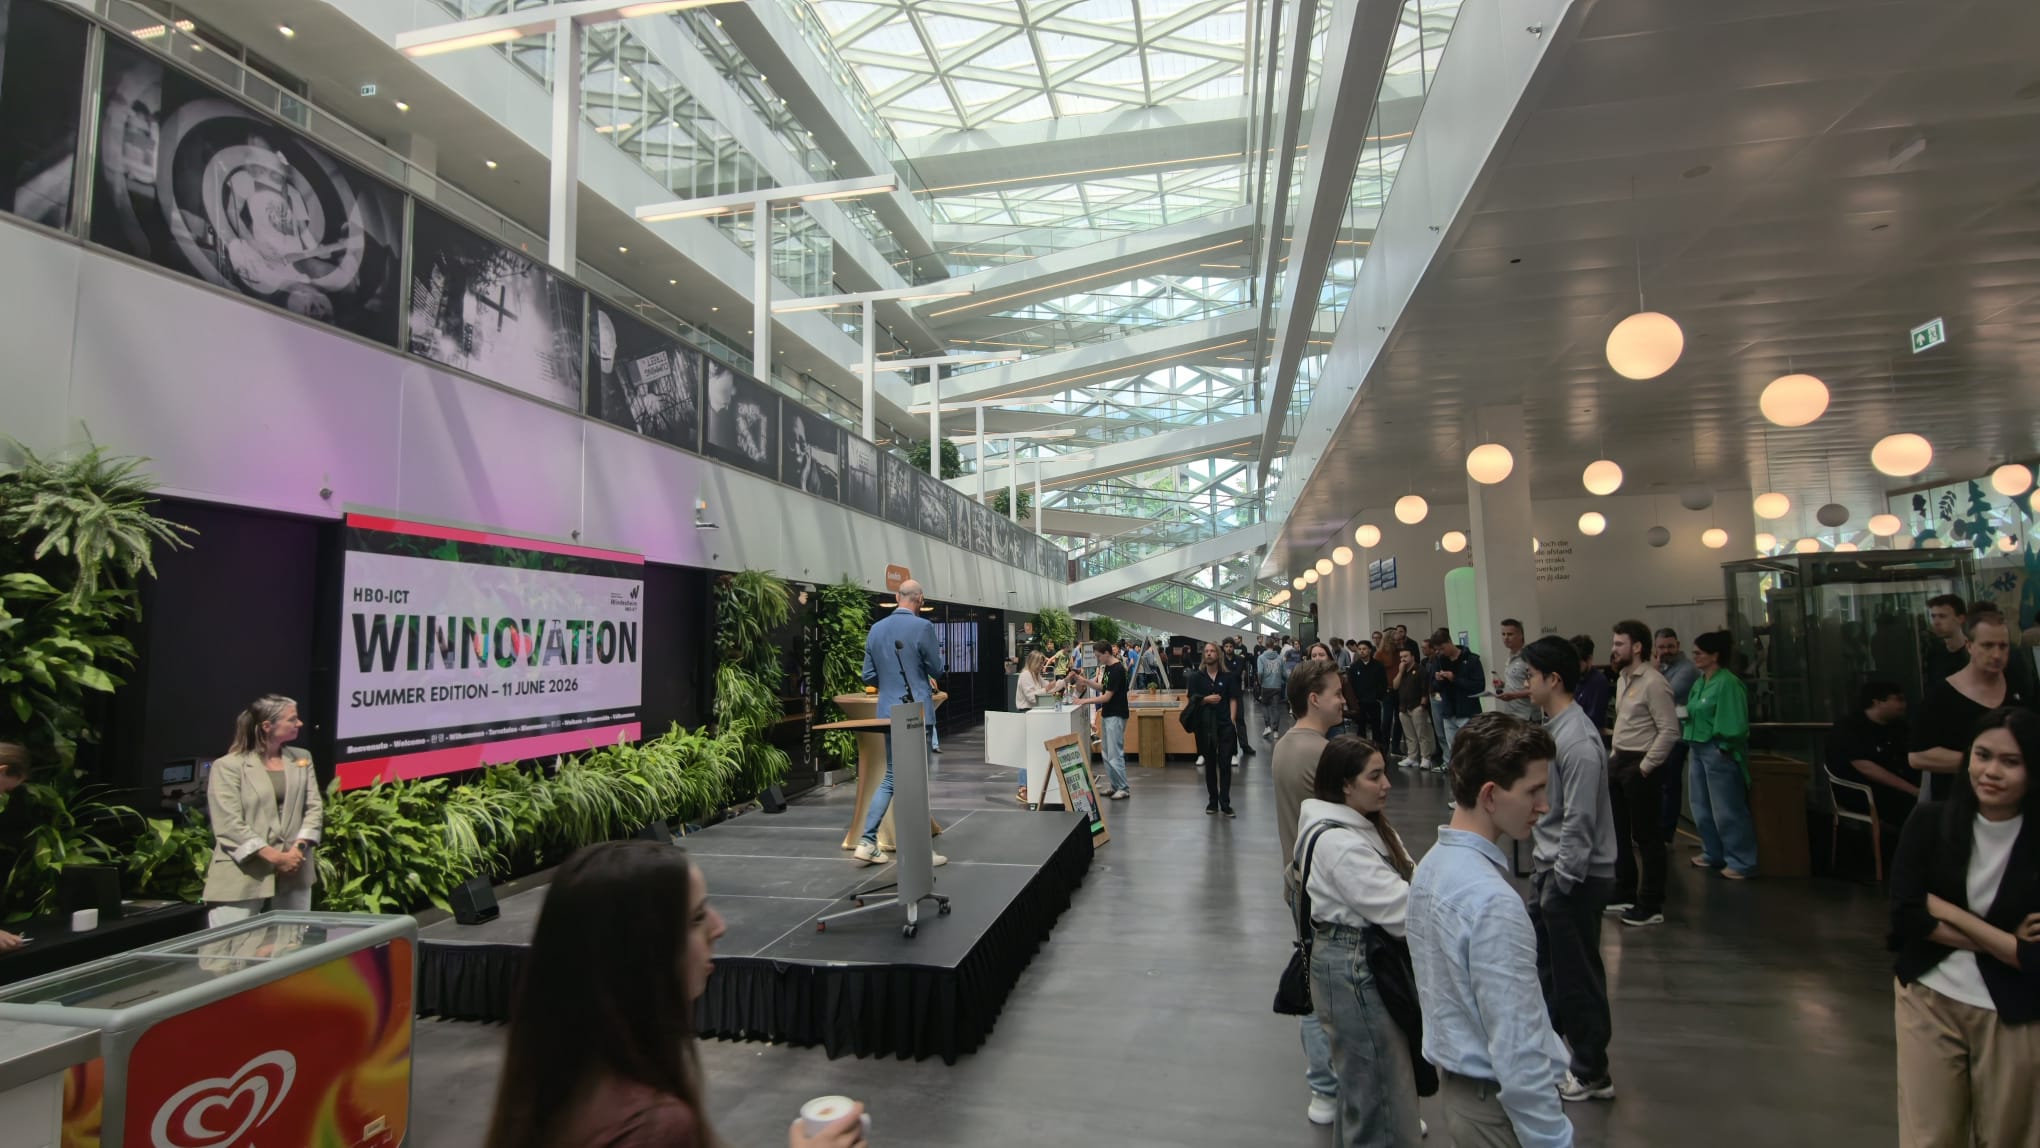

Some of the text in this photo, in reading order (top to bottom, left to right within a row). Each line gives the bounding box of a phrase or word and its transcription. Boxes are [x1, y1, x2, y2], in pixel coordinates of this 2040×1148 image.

[353, 587, 410, 604] HBO-ICT
[351, 613, 637, 673] WINNOVATION
[351, 687, 426, 708] SUMMER
[431, 683, 489, 702] EDITION
[502, 682, 512, 696] 11
[515, 680, 545, 696] JUNE
[548, 678, 579, 693] 2026
[803, 671, 813, 765] Collegezaal
